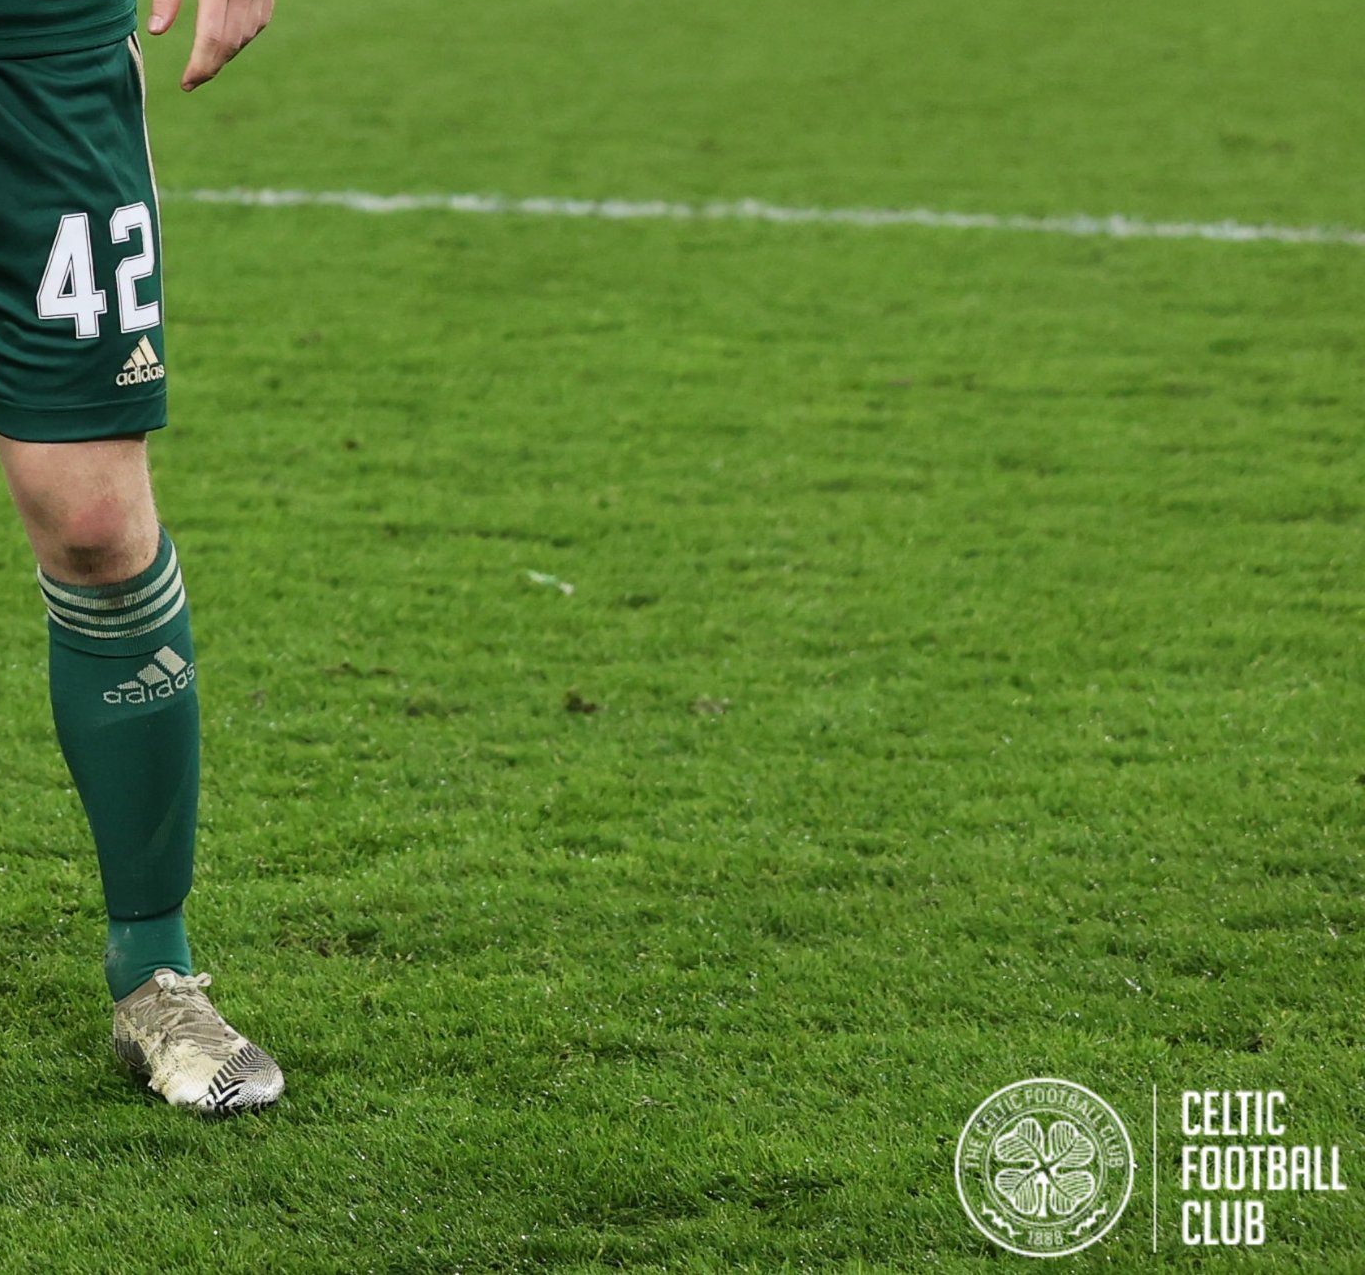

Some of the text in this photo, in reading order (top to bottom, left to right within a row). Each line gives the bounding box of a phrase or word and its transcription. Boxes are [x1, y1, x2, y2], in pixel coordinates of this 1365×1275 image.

[36, 202, 162, 339] 42
[115, 362, 165, 387] adidas
[102, 662, 197, 705] adidas
